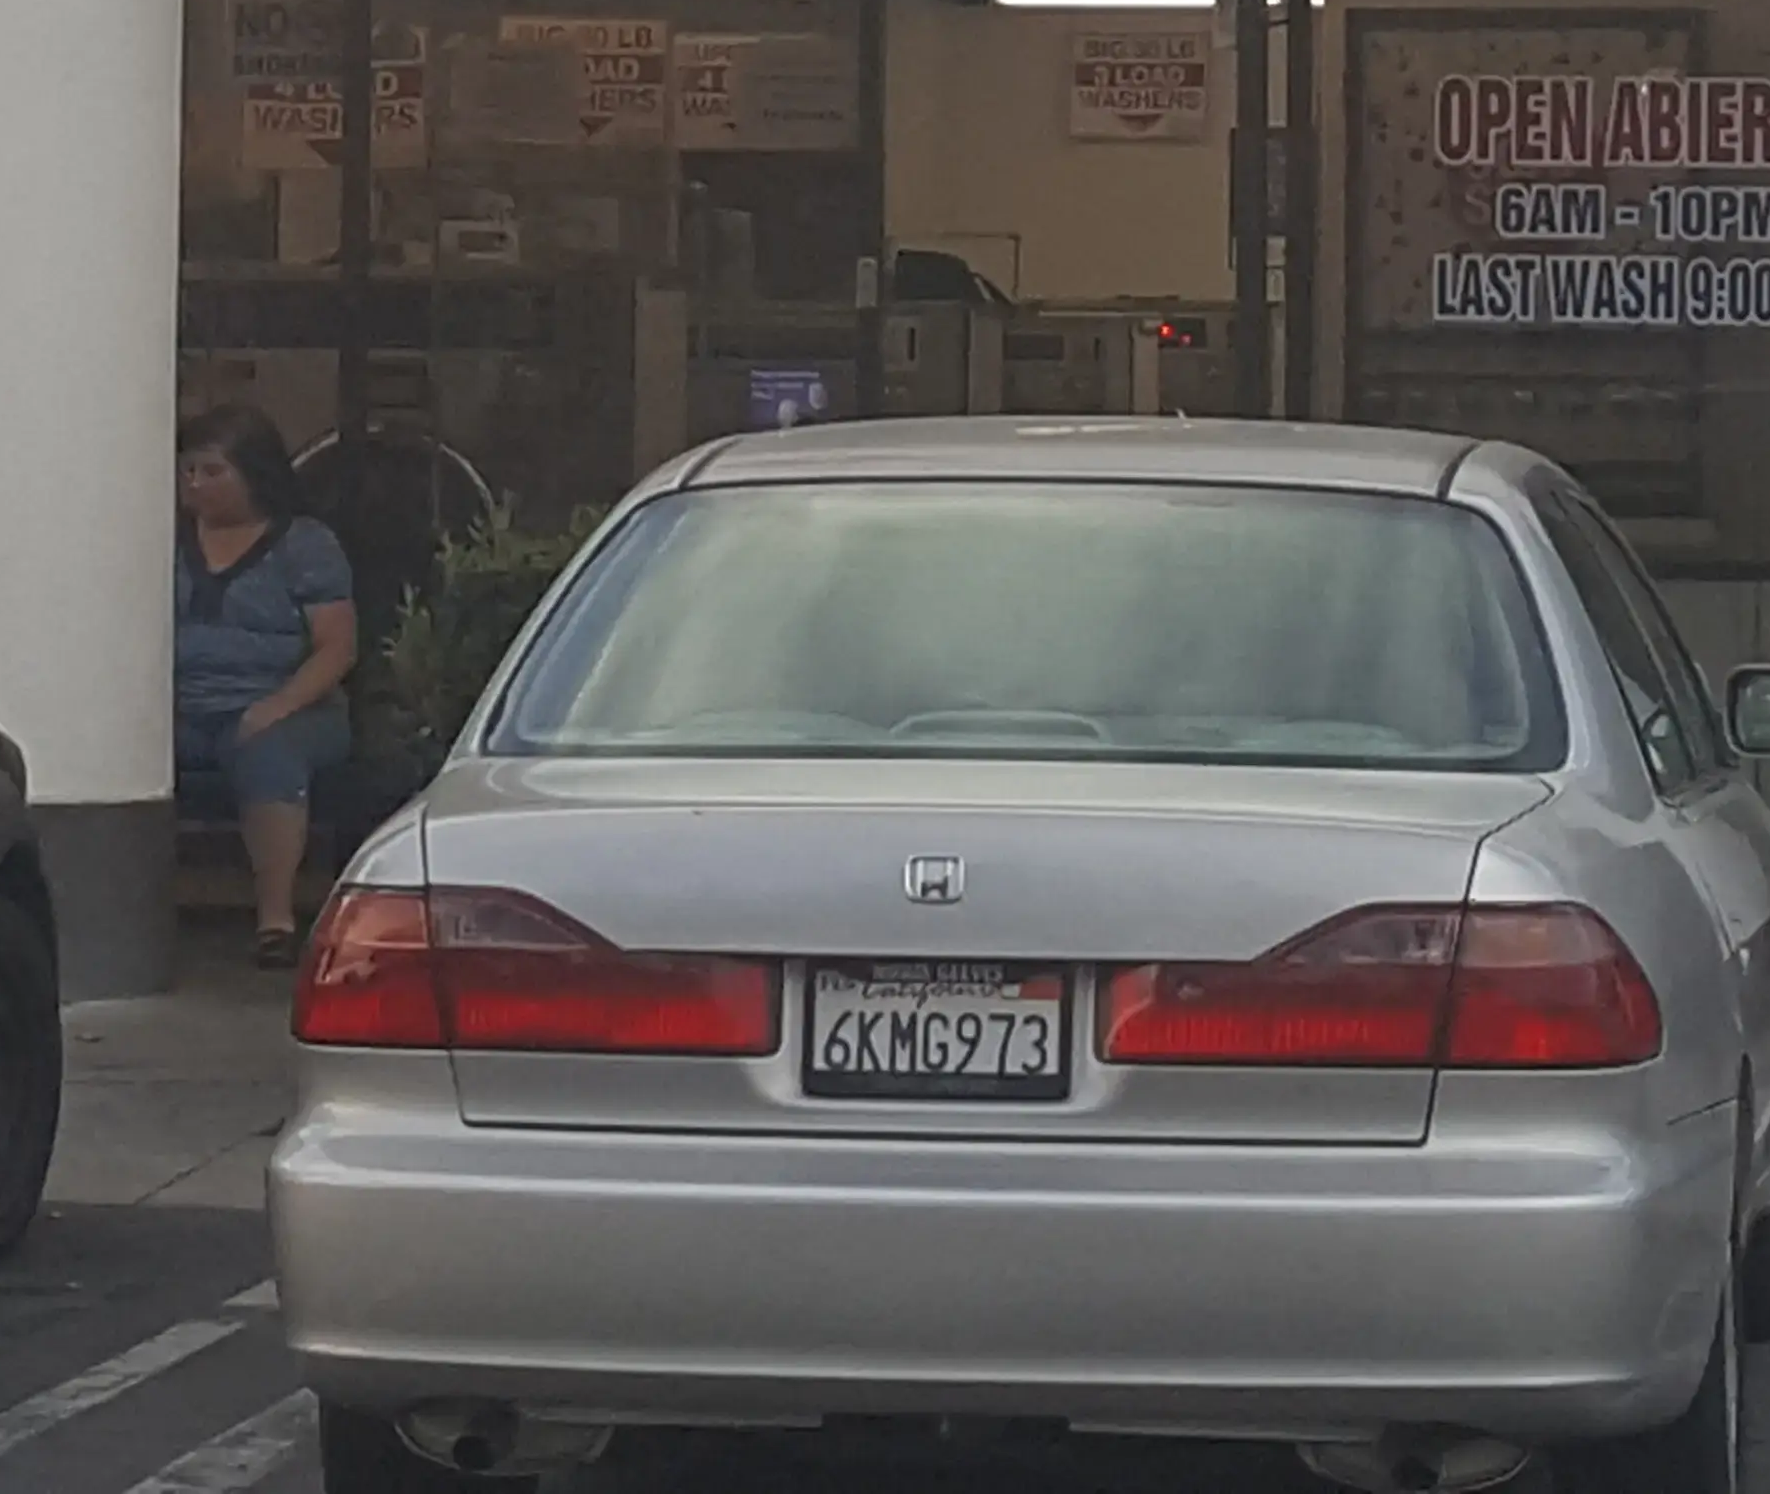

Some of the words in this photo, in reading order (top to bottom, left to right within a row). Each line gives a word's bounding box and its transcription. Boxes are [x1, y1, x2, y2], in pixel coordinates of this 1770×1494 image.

[1434, 74, 1593, 166] OPEN
[1495, 184, 1606, 239] 6AM
[1433, 254, 1540, 322] LAST
[1545, 257, 1679, 326] WASH
[823, 1009, 1050, 1078] 6KMG973
